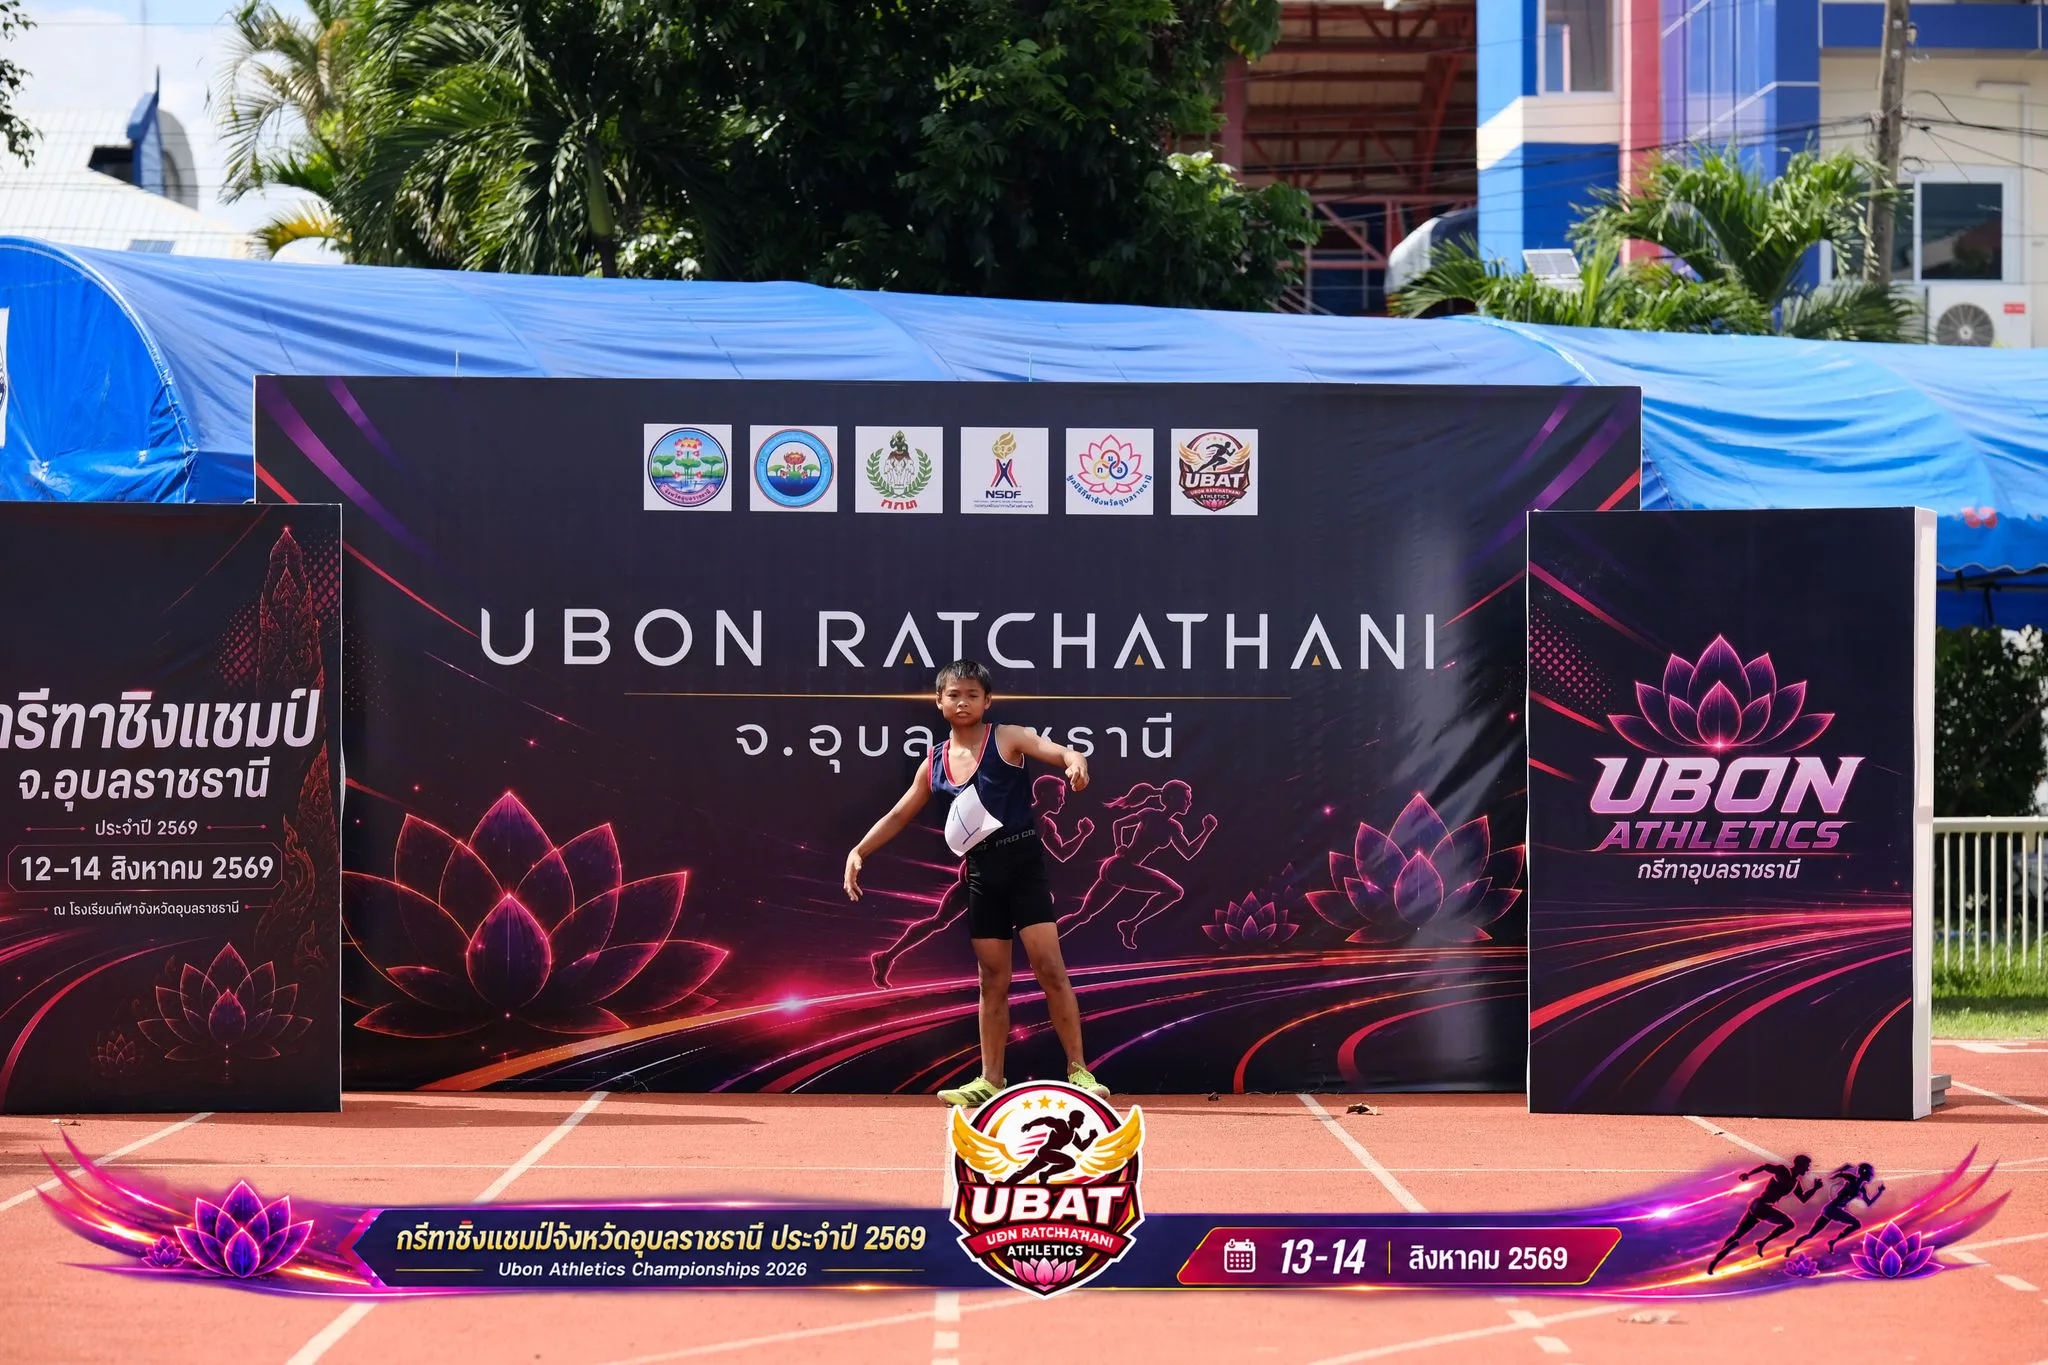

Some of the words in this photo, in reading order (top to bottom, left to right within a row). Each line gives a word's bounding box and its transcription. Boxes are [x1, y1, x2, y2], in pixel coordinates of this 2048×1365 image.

[1185, 473, 1245, 489] UBAT
[985, 490, 1022, 499] NSDF
[481, 608, 762, 666] UBON
[818, 611, 1434, 670] RATCHATHANI
[18, 756, 271, 812] จ.อุบลราชธานี
[1591, 757, 1866, 814] UBON
[95, 818, 152, 836] ประจำปี
[157, 820, 198, 835] 2569
[1592, 821, 1850, 850] ATHLETICS
[995, 834, 1020, 848] PRO
[21, 856, 101, 881] 12-14
[111, 855, 203, 881] สิงหาคม
[212, 856, 274, 879] 2569
[1637, 858, 1801, 885] กรีฑาอุบลราชธานี
[53, 905, 66, 916] ณ
[70, 900, 240, 918] โรงเรียนกีฬาจังหวัดอุบลราชธานี
